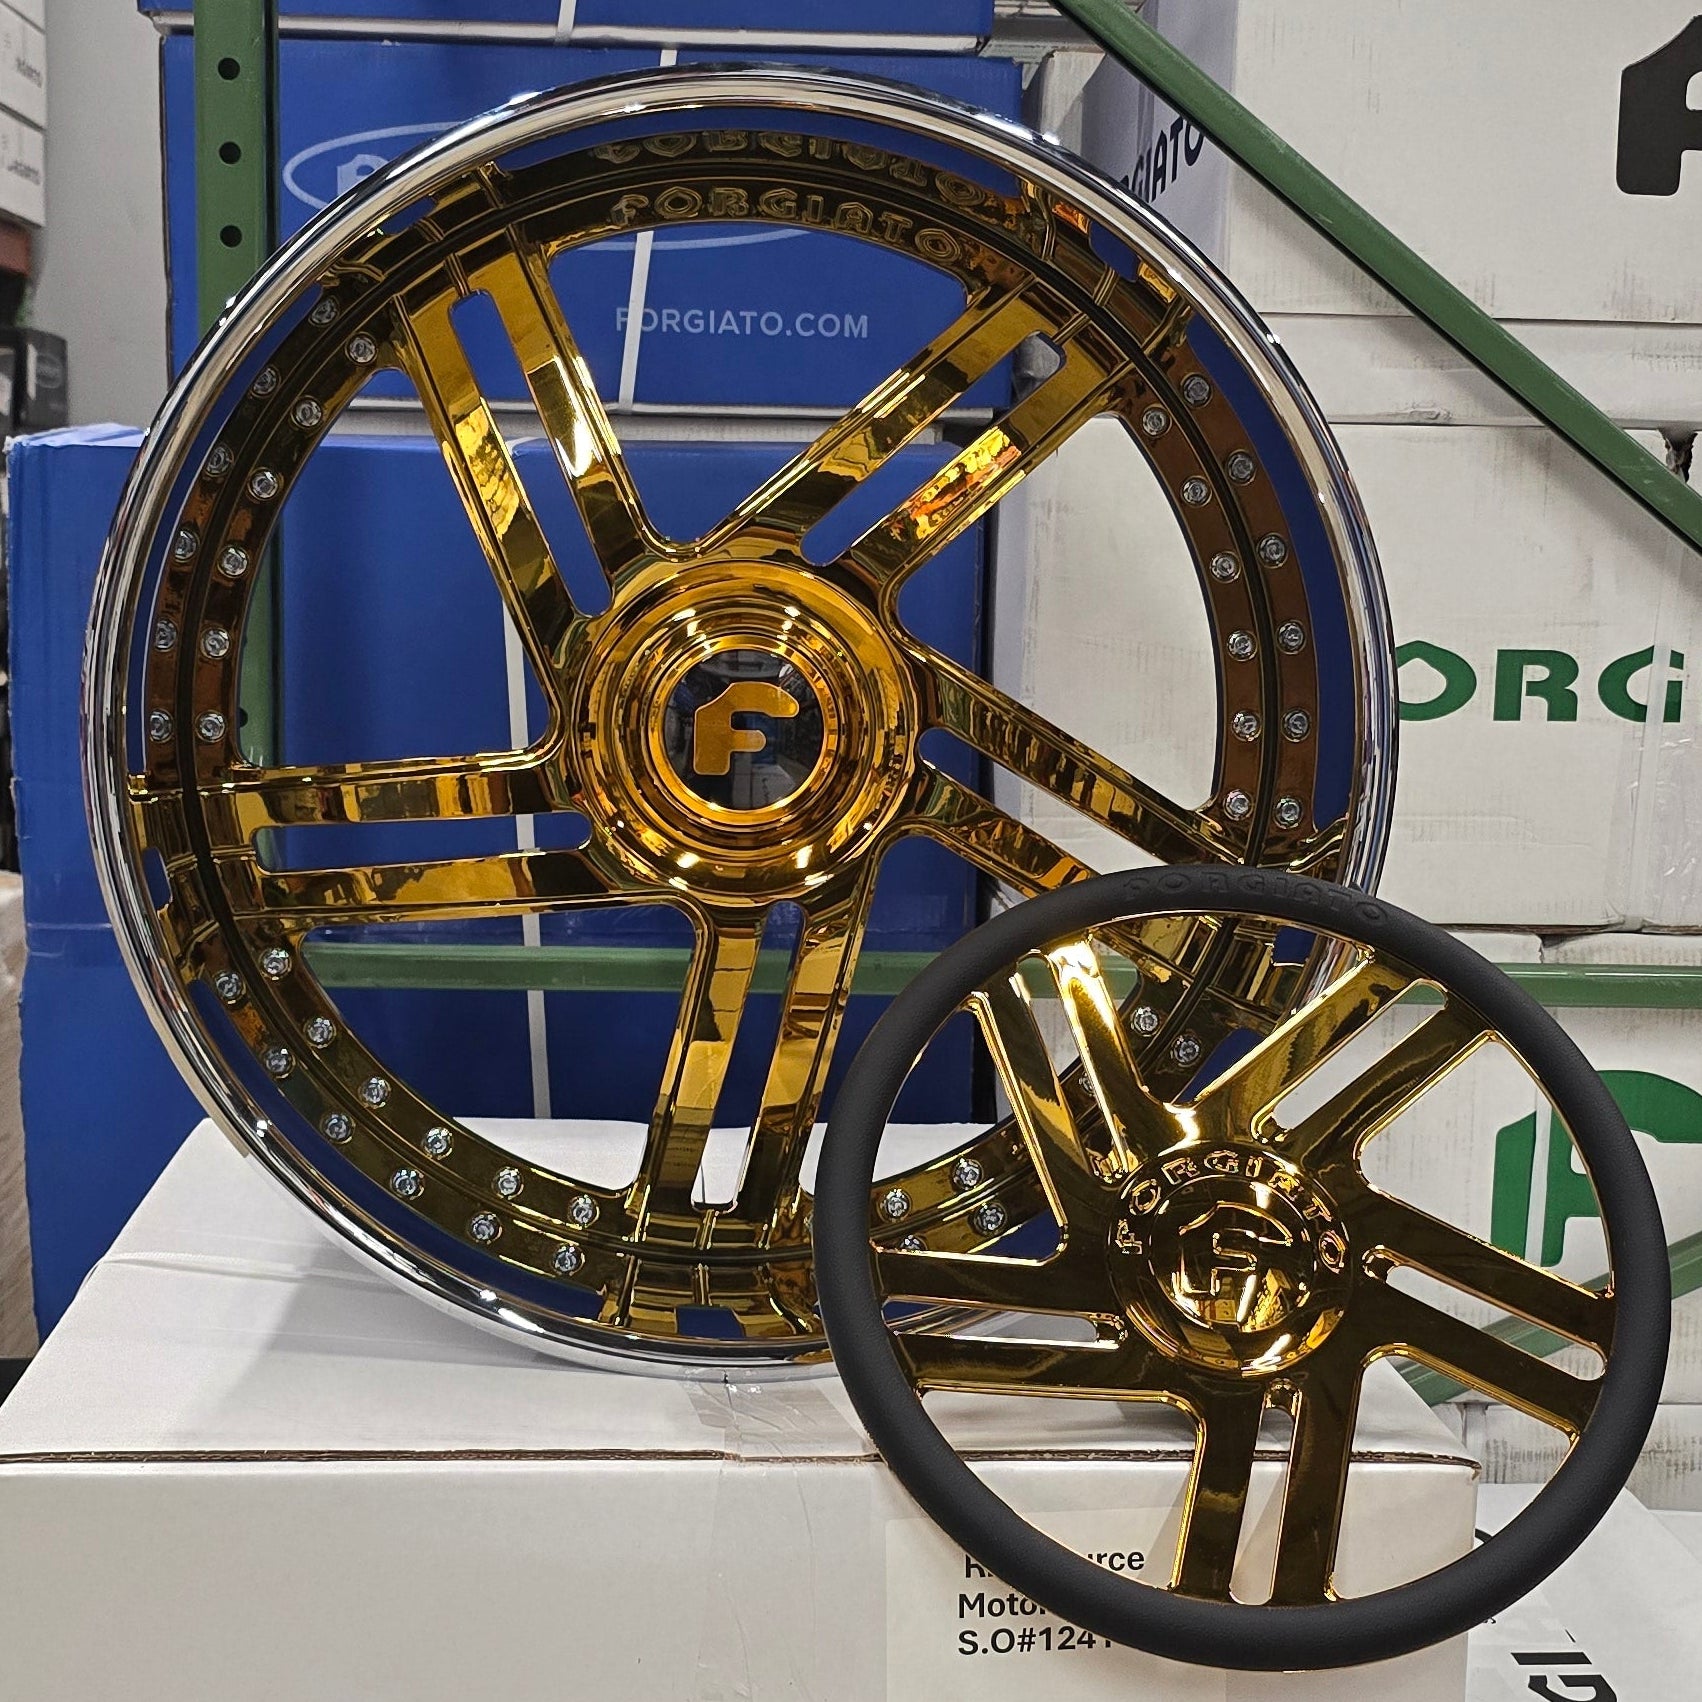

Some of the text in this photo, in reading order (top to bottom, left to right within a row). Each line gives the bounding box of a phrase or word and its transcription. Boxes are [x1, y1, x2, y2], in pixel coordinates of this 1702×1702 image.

[1120, 116, 1204, 203] GIATO
[610, 186, 963, 263] FORGIATO
[616, 307, 868, 338] FORGIATO.COM
[693, 681, 799, 775] F
[1122, 871, 1388, 925] FORGIATO
[1115, 1149, 1346, 1275] FORGIATO
[958, 1592, 1046, 1619] Moto
